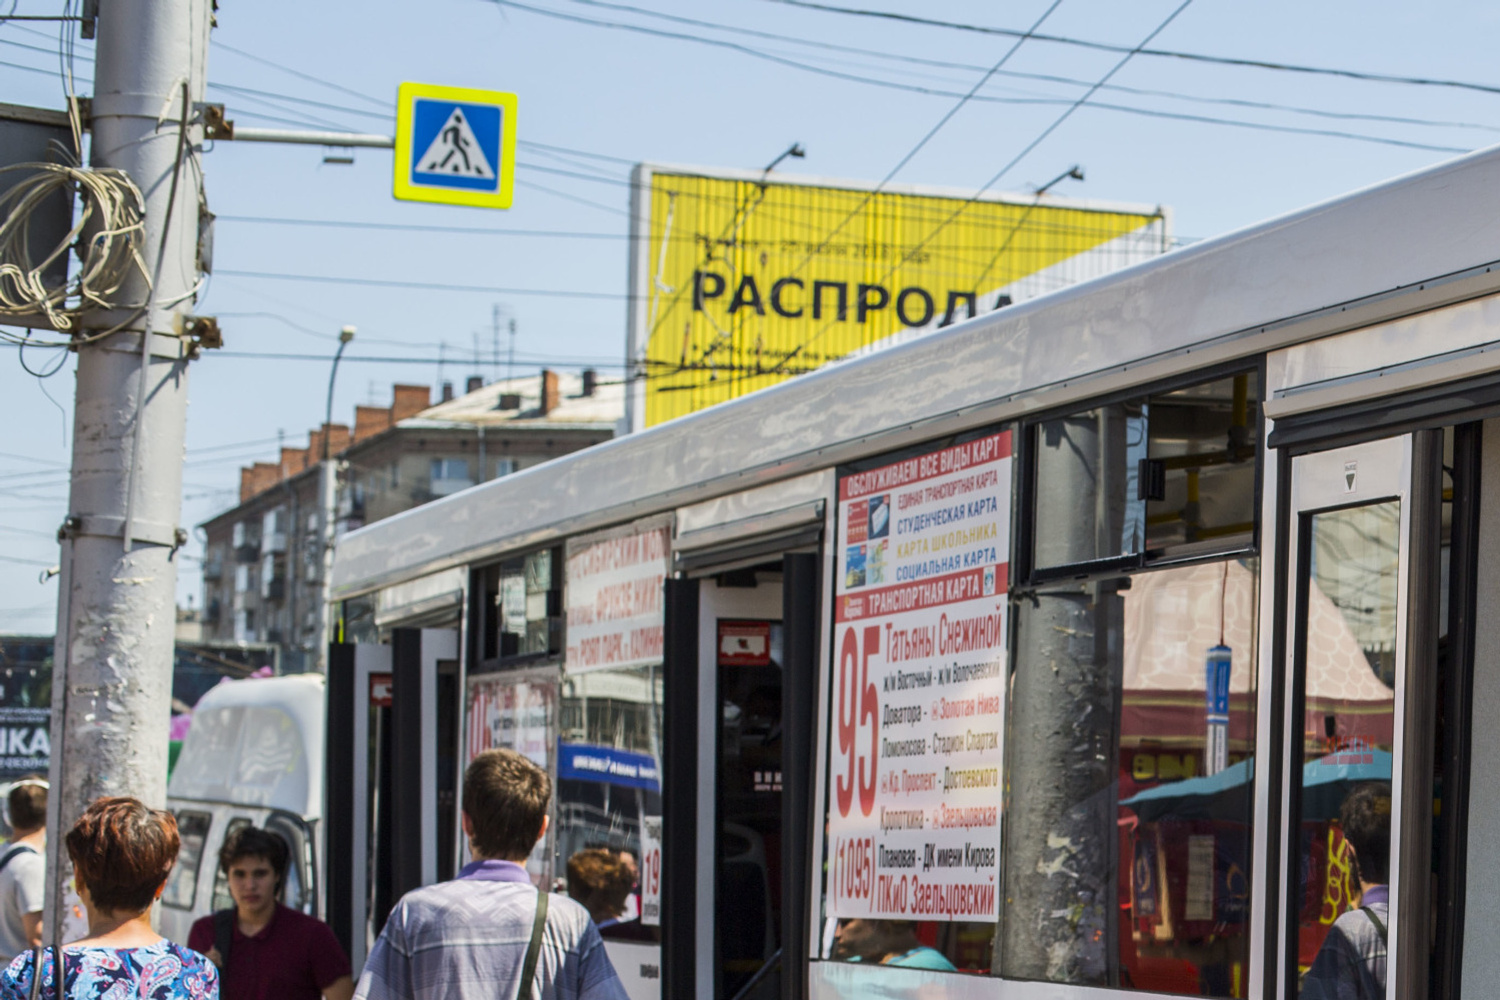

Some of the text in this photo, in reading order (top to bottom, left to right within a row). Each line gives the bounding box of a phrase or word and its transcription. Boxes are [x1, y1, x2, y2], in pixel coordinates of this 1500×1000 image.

[847, 436, 999, 496] ОБСЛУЖИВАЕМ ВСЕ ВИДЫ КАРТ
[898, 470, 998, 510] ЕДИНАЯ ТРАНСПОРТНАЯ КАРТА
[897, 496, 997, 535] СТУДЕНЧЕСКАЯ КАРТА
[897, 522, 997, 559] КАРТА ШКОЛЬНИКА
[896, 547, 996, 582] СОЦИАЛЬНАЯ КАРТА
[868, 574, 979, 614] ТРАНСПОРТНАЯ КАРТА
[886, 603, 1002, 664] Татьяны Снежиной
[837, 625, 881, 818] 95
[940, 697, 975, 720] Золотая
[978, 692, 999, 714] Нива
[967, 729, 999, 755] Спартак
[943, 766, 998, 794] Достоевского
[941, 802, 997, 832] Заельцовская
[834, 836, 876, 913] (1095)
[879, 842, 995, 873] Плановая ДК имени Кирова
[877, 874, 994, 920] ПКиО Заельцовский
